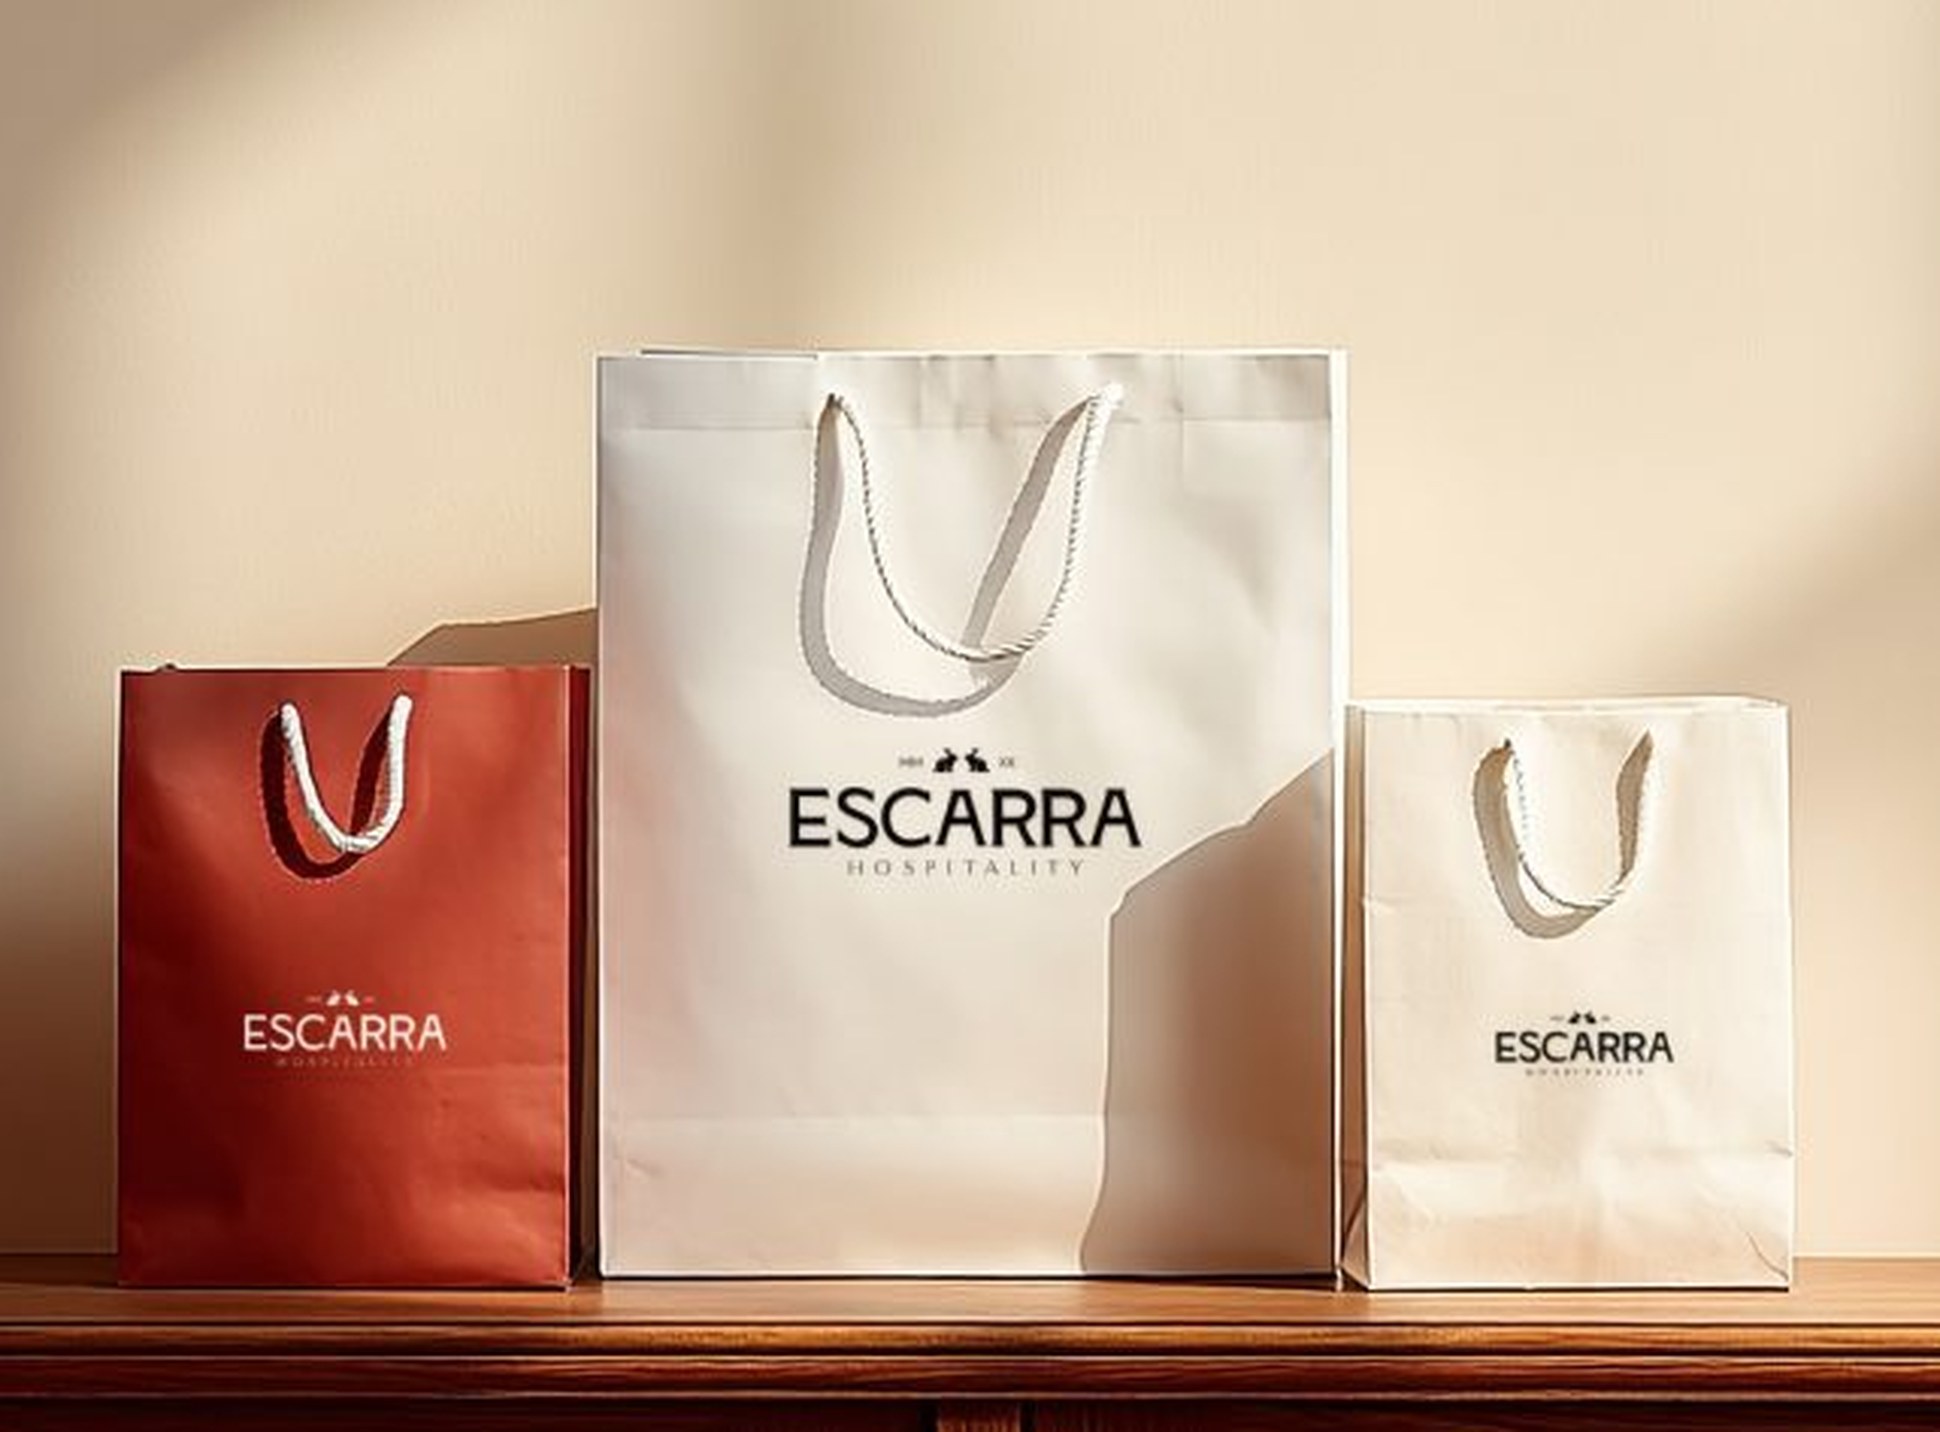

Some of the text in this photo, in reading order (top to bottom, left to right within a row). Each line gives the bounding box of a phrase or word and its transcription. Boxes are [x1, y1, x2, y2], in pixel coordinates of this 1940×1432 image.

[788, 786, 1142, 849] ESCARRA
[846, 858, 1086, 877] HOSPITALITY
[243, 1013, 447, 1051] ESCARRA
[1494, 1030, 1674, 1064] ESCARRA
